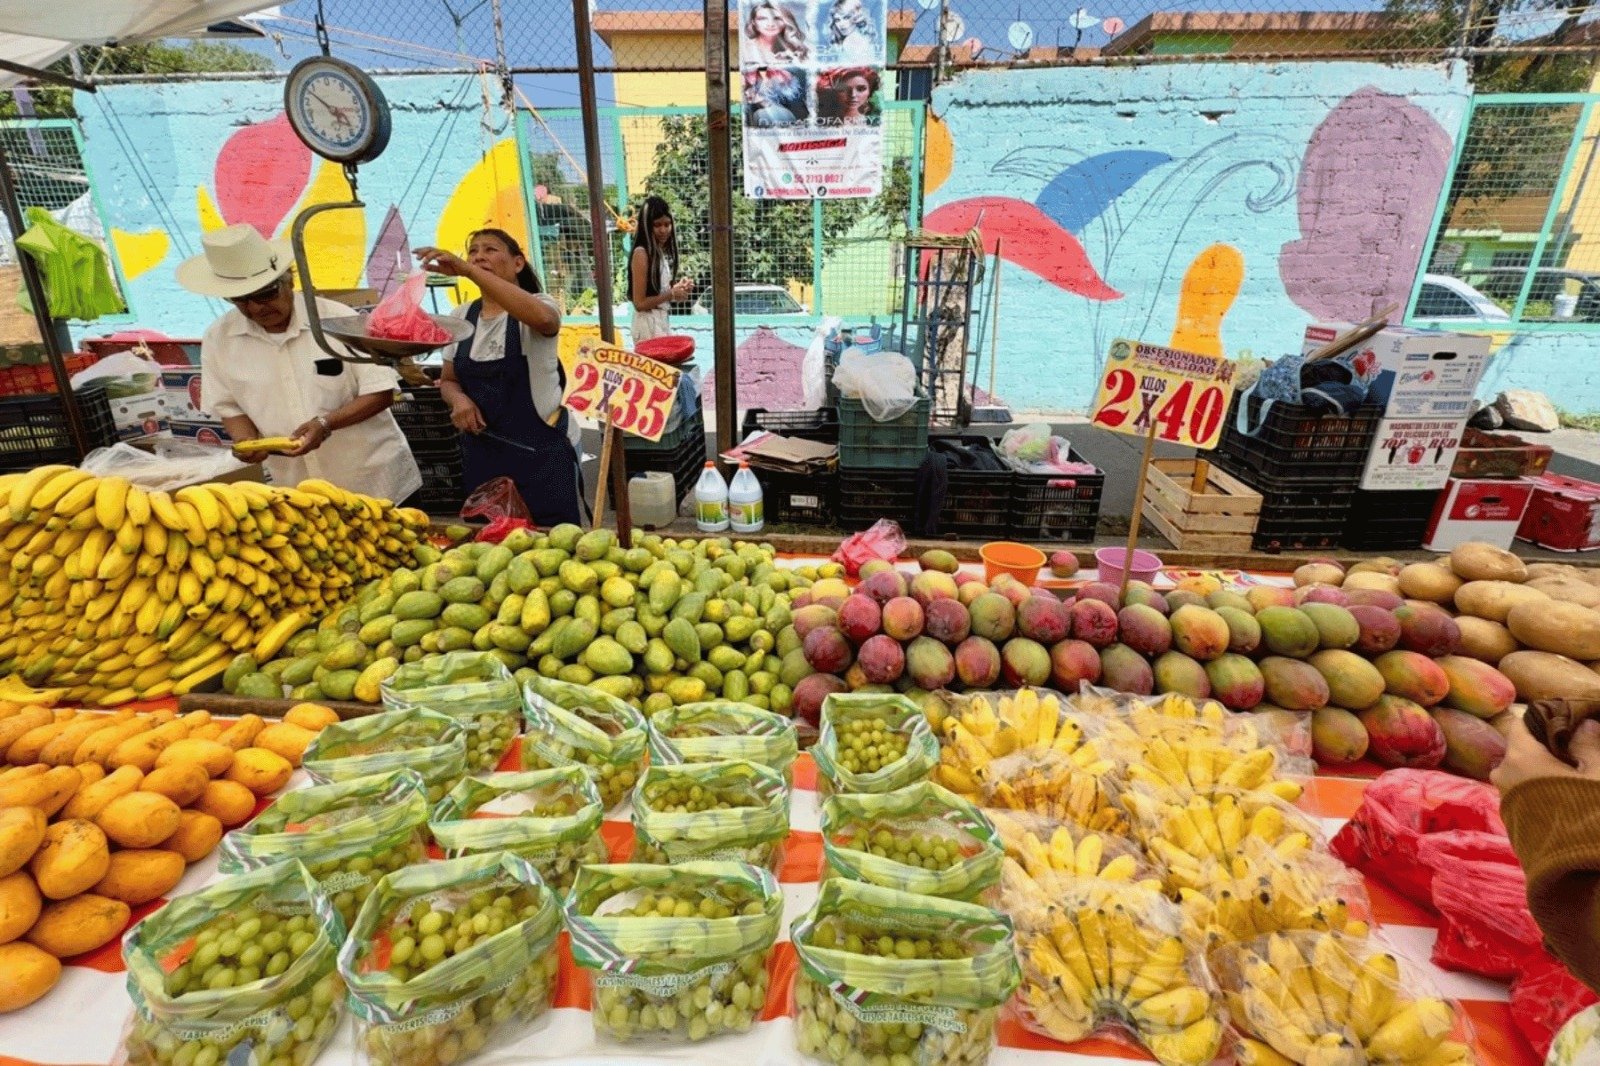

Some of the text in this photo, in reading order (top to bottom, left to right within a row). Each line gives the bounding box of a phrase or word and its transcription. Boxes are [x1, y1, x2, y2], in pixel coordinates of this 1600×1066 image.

[594, 348, 675, 389] CHULADA
[1136, 344, 1217, 367] OBSESIONADOS
[565, 363, 599, 412] 2
[595, 382, 617, 413] X
[1093, 368, 1136, 427] 2
[1139, 375, 1168, 393] KILOS
[611, 377, 673, 438] 35
[1132, 392, 1160, 428] X
[1156, 380, 1224, 445] 40
[1381, 438, 1407, 449] TOP
[1428, 438, 1458, 449] RED
